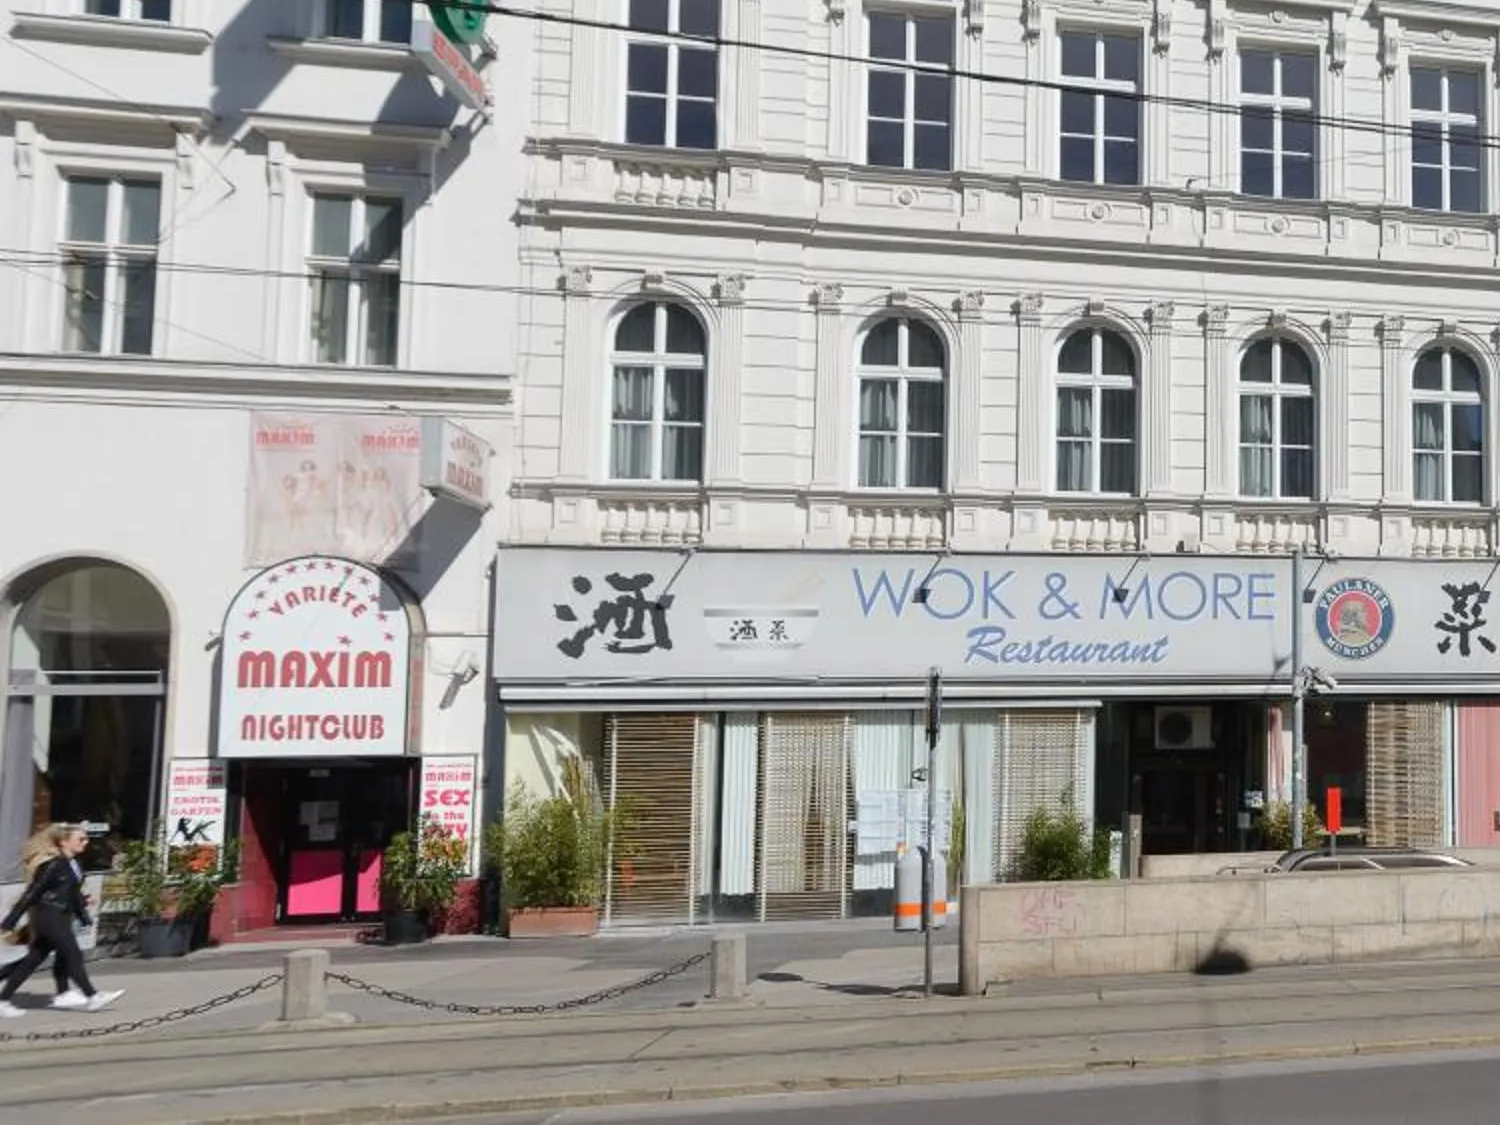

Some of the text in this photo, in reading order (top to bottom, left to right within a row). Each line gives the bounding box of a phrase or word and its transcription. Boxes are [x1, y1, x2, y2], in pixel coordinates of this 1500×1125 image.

[853, 568, 1276, 621] WOK & MORE
[1319, 579, 1389, 609] PAULANER
[964, 626, 1169, 664] Restaurant
[237, 650, 392, 688] MAXIM
[241, 714, 385, 741] NIGHTCLUB
[424, 788, 471, 807] SEX
